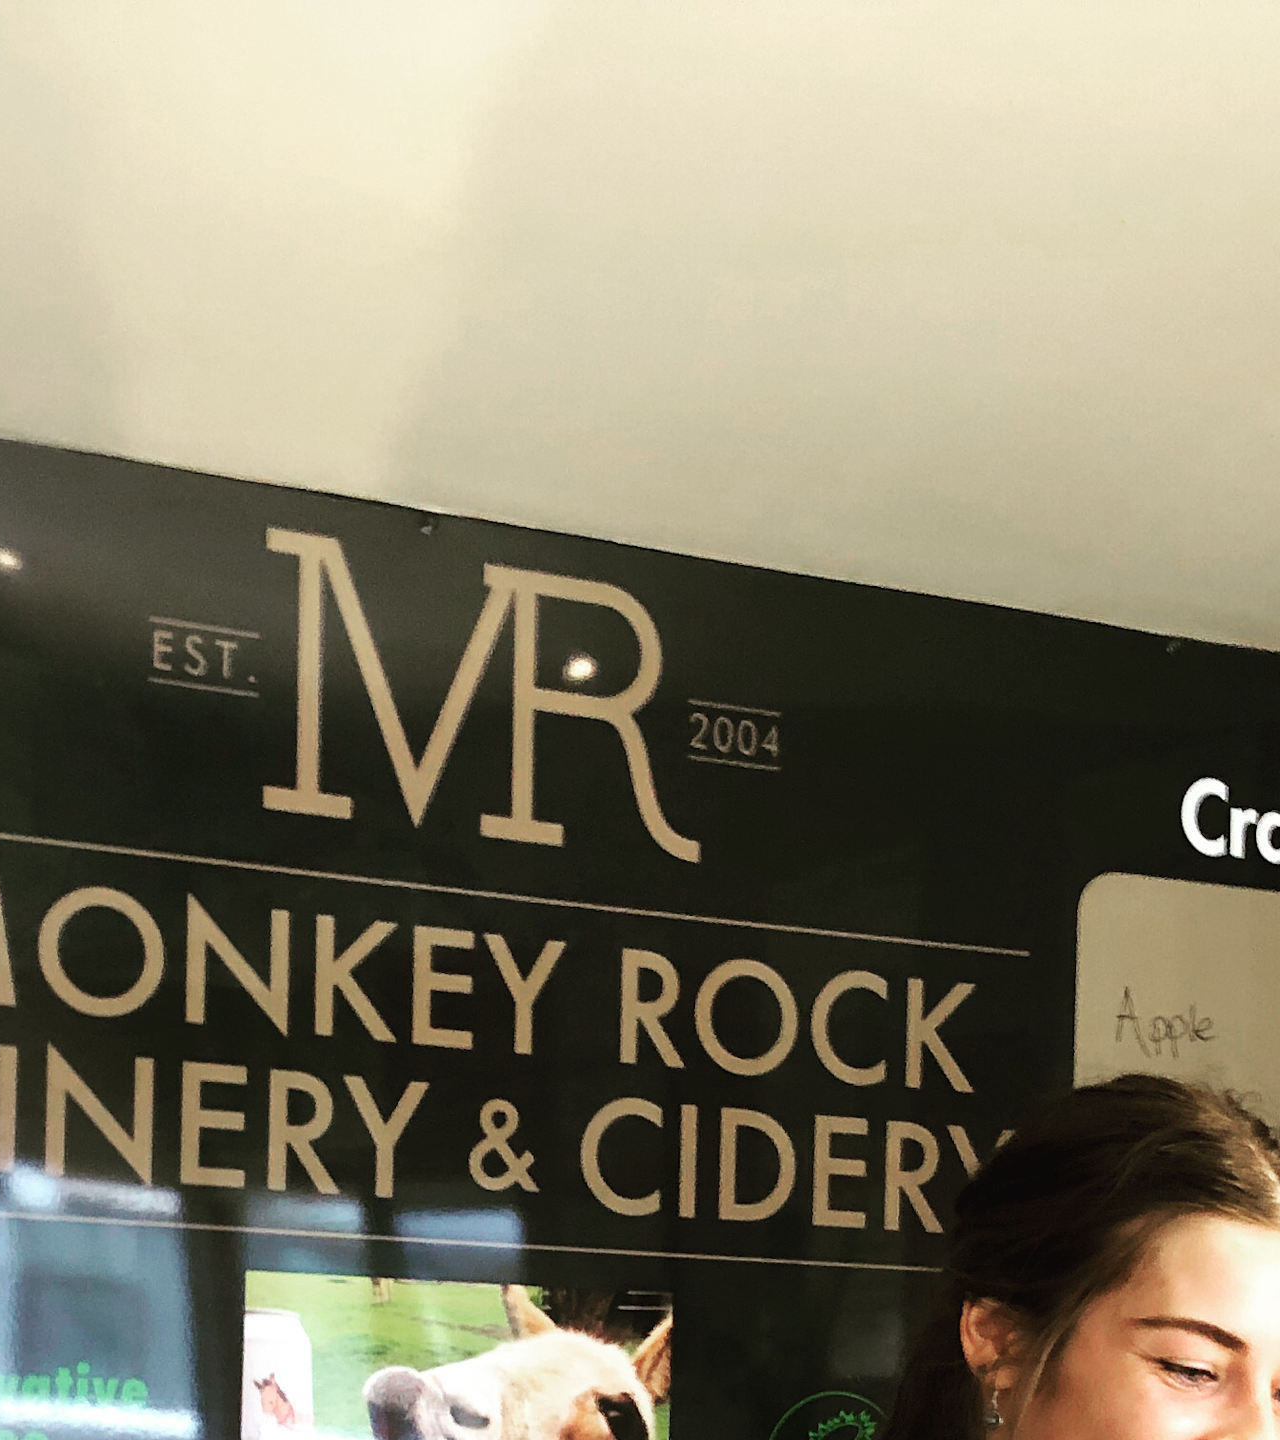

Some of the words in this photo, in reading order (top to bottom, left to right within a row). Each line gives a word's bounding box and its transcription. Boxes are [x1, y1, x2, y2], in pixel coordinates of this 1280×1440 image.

[152, 629, 258, 684] EST.
[262, 526, 702, 864] MR
[688, 710, 782, 760] 2004
[619, 946, 976, 1095] ROCK
[1114, 985, 1217, 1058] Apple
[470, 1096, 541, 1195] &
